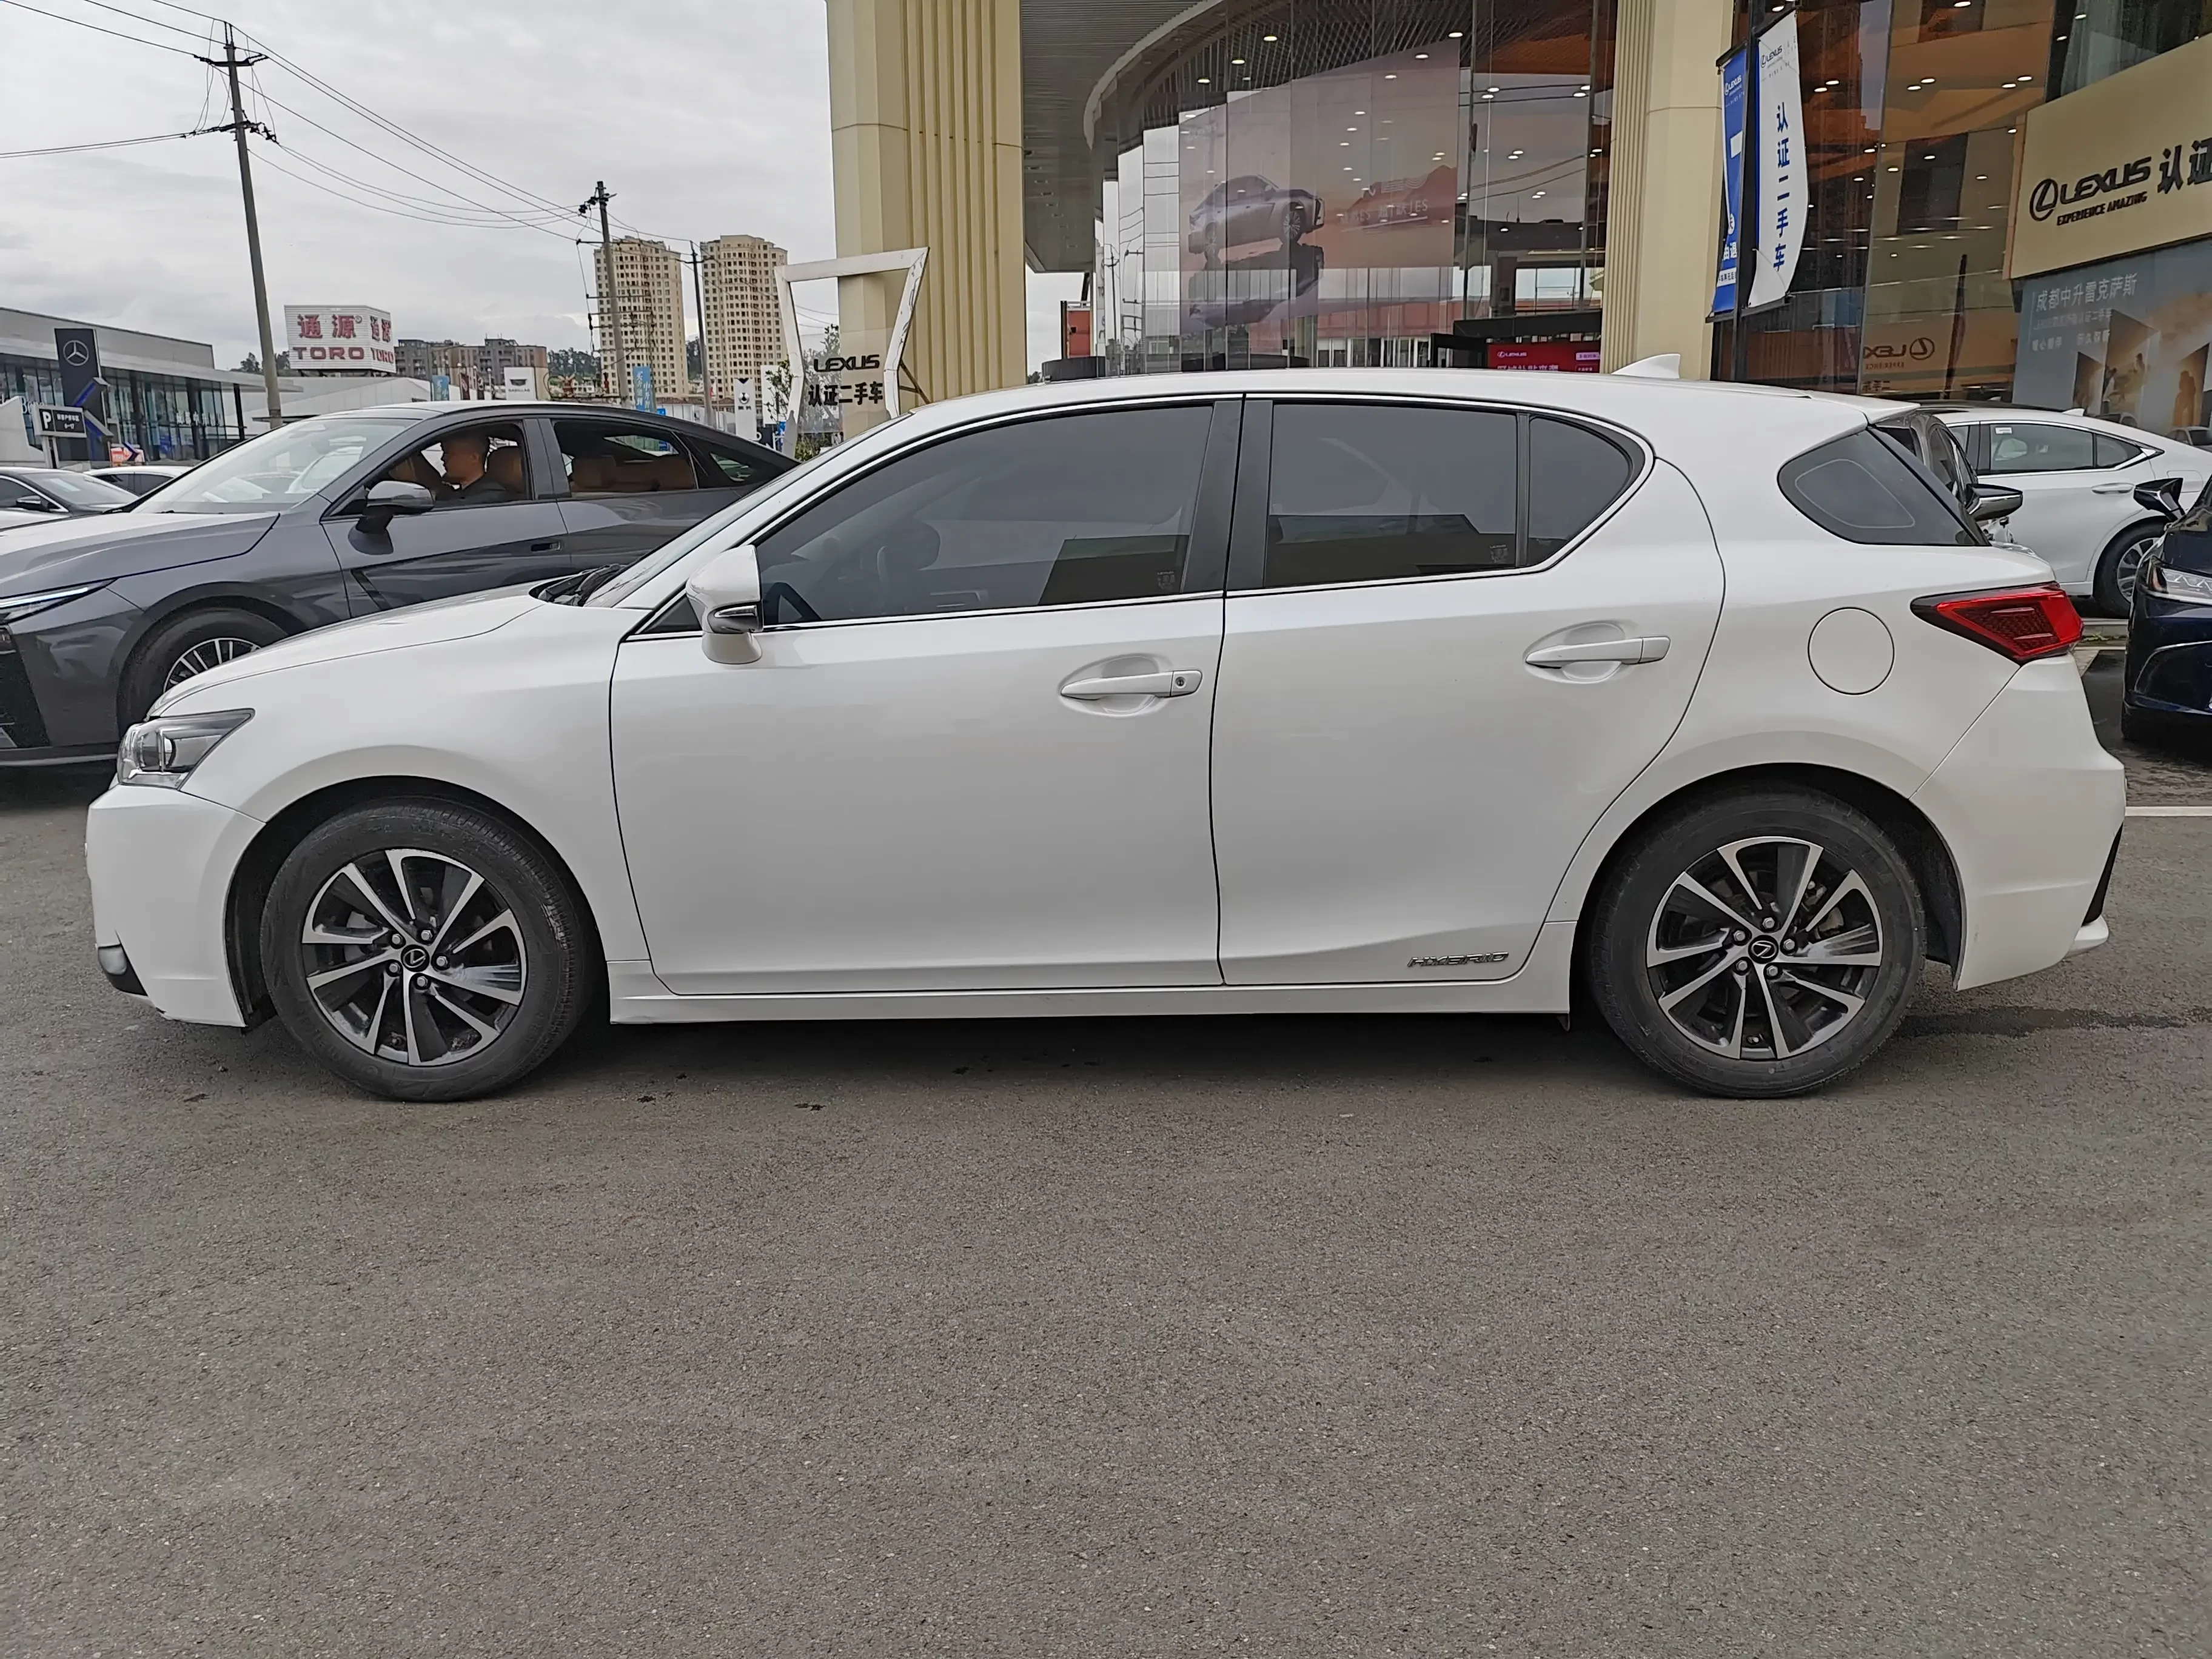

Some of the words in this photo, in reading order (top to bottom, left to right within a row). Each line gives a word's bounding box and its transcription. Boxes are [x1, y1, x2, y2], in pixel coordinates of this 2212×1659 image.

[1766, 45, 1782, 62] LEXUS
[1773, 101, 1790, 272] 认证二手车
[2060, 156, 2151, 204] LEXUS
[2056, 203, 2106, 226] EXPERIENCE
[2107, 191, 2148, 213] AMAZING
[2036, 273, 2137, 312] 成都中升雷克萨斯
[292, 347, 364, 360] TORO
[370, 347, 394, 364] TORO
[813, 354, 880, 372] LEXUS
[808, 381, 883, 407] 认证二手车
[42, 411, 52, 429] P
[1407, 951, 1509, 968] HYBRID
